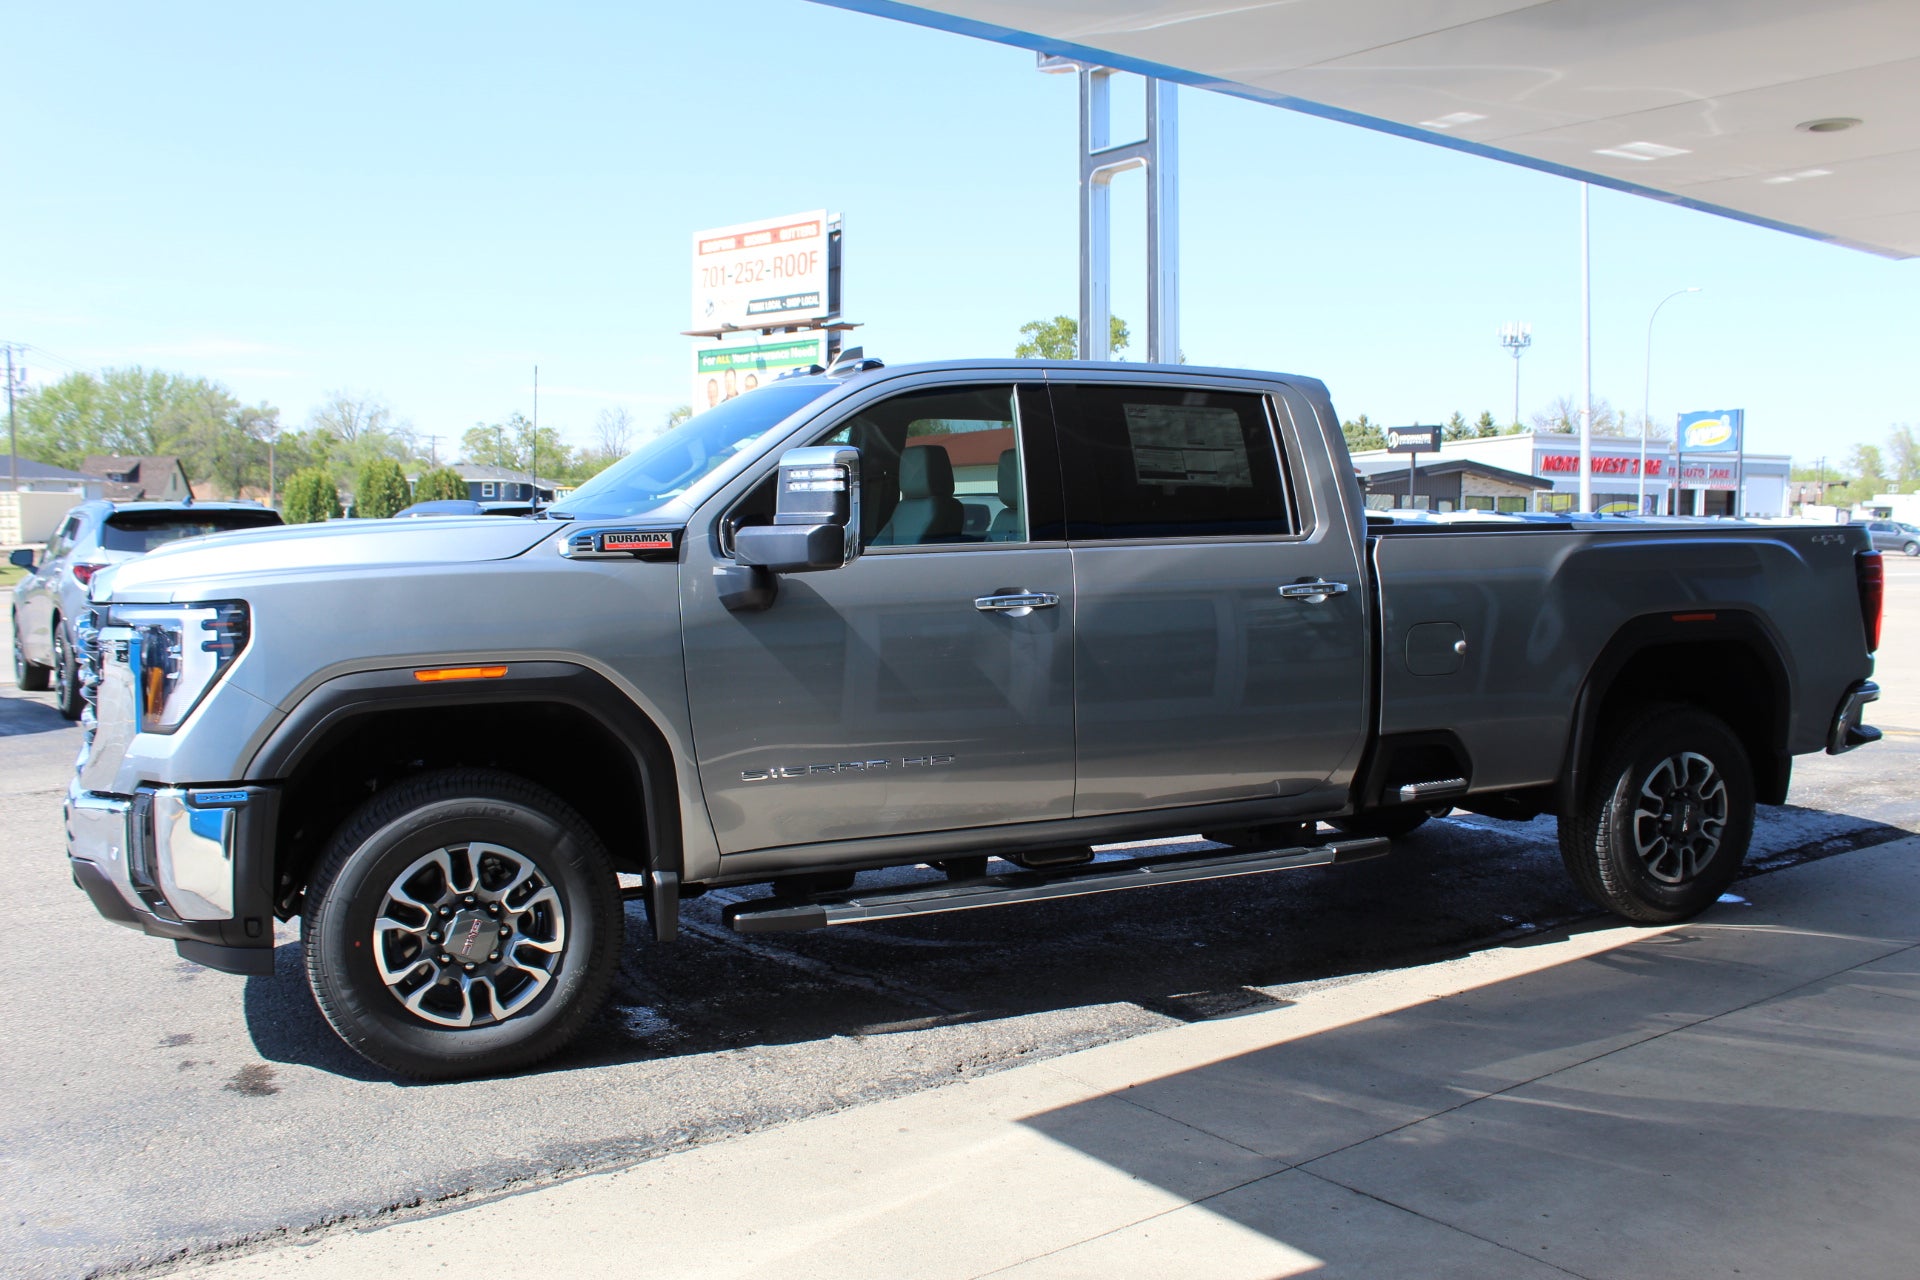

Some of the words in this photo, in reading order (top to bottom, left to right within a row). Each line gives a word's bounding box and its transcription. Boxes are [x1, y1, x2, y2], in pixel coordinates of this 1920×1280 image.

[701, 250, 819, 288] 701-252-ROOF
[608, 534, 668, 543] DURAMAX
[741, 760, 891, 781] SIERRA
